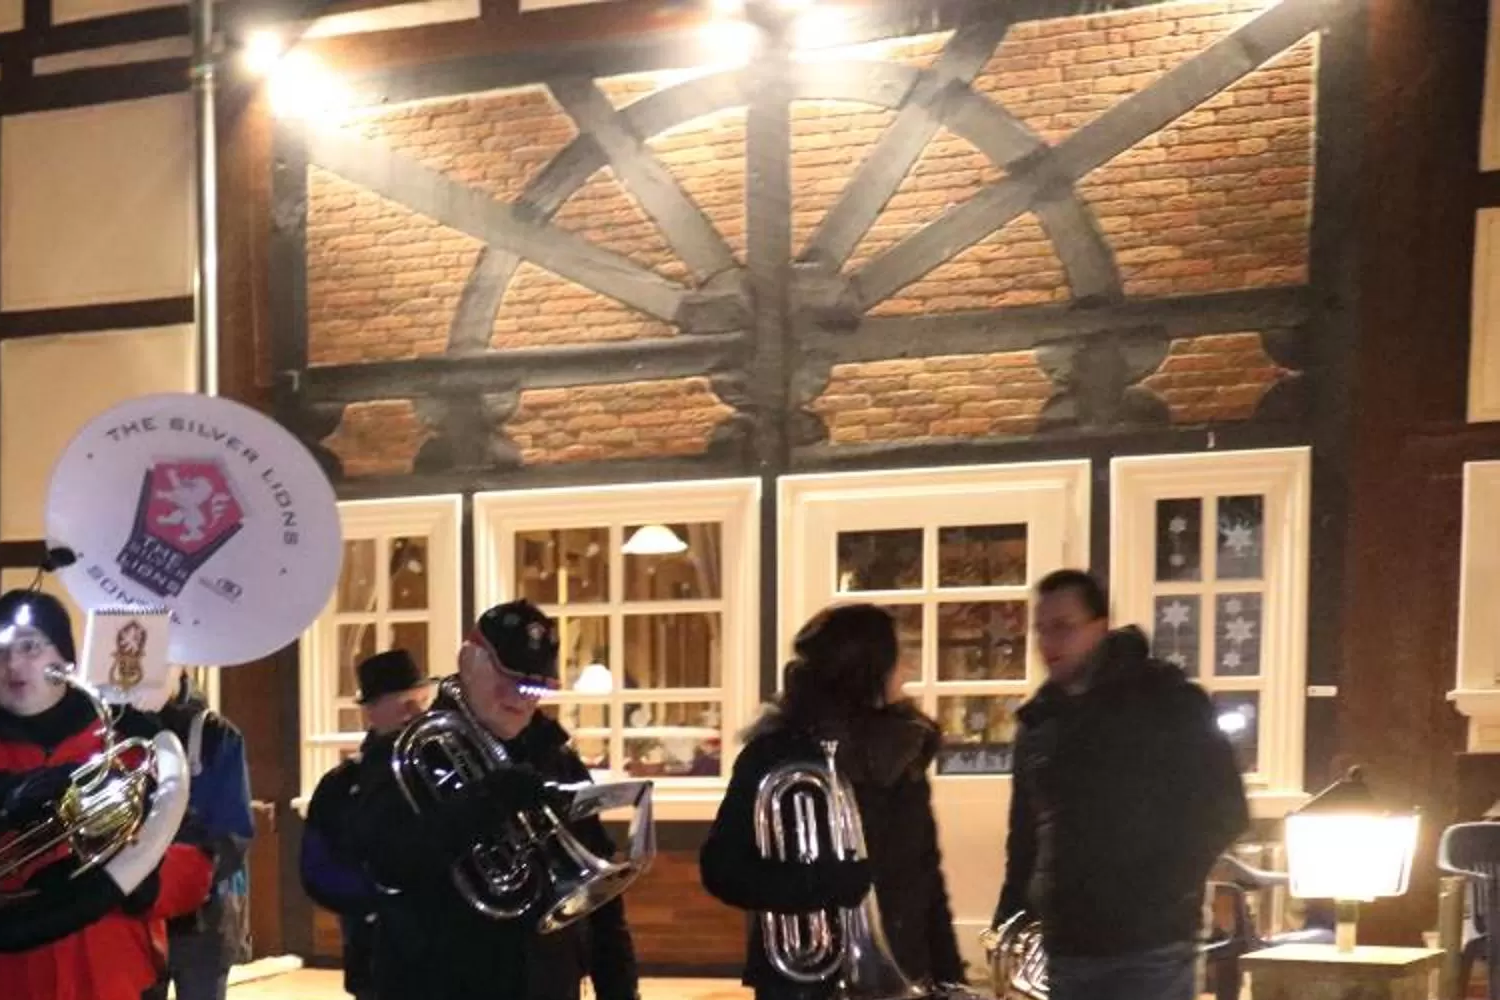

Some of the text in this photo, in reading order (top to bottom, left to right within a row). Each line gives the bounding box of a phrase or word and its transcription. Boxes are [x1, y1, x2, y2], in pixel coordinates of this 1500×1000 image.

[105, 417, 299, 545] THE SILVER LIONS
[143, 535, 184, 565] THE
[119, 553, 181, 594] LIONS
